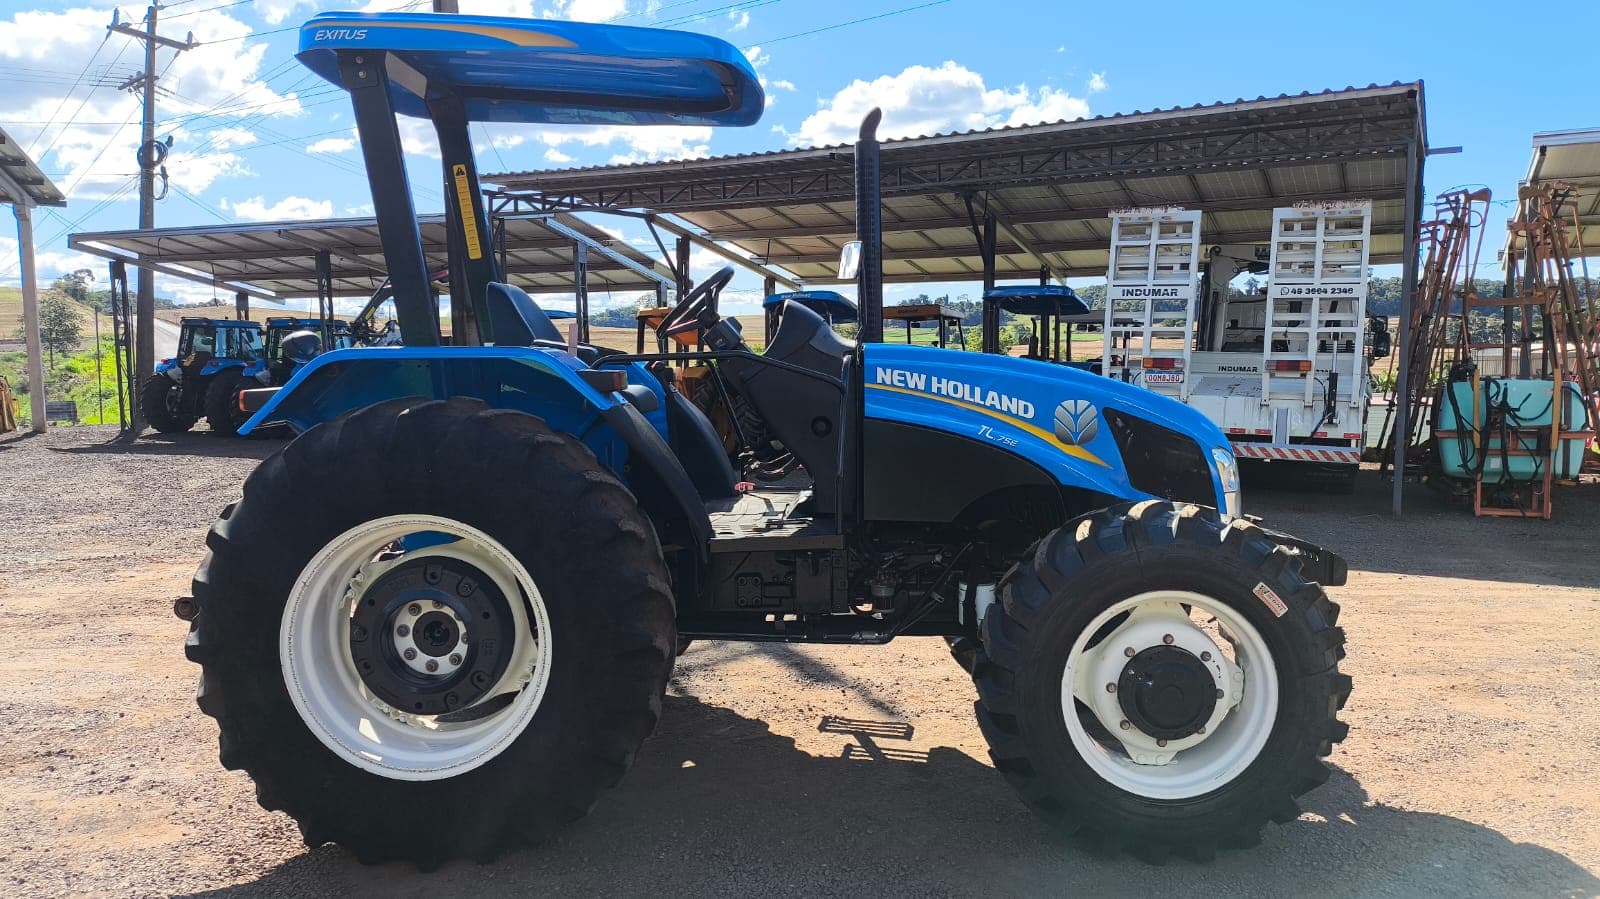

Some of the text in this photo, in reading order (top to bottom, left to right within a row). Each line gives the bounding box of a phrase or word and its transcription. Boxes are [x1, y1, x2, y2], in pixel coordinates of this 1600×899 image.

[314, 29, 368, 41] EXITUS
[1121, 288, 1179, 297] INDUMAR
[1218, 365, 1258, 373] INDUMAR
[876, 366, 1035, 419] NEW HOLLAND
